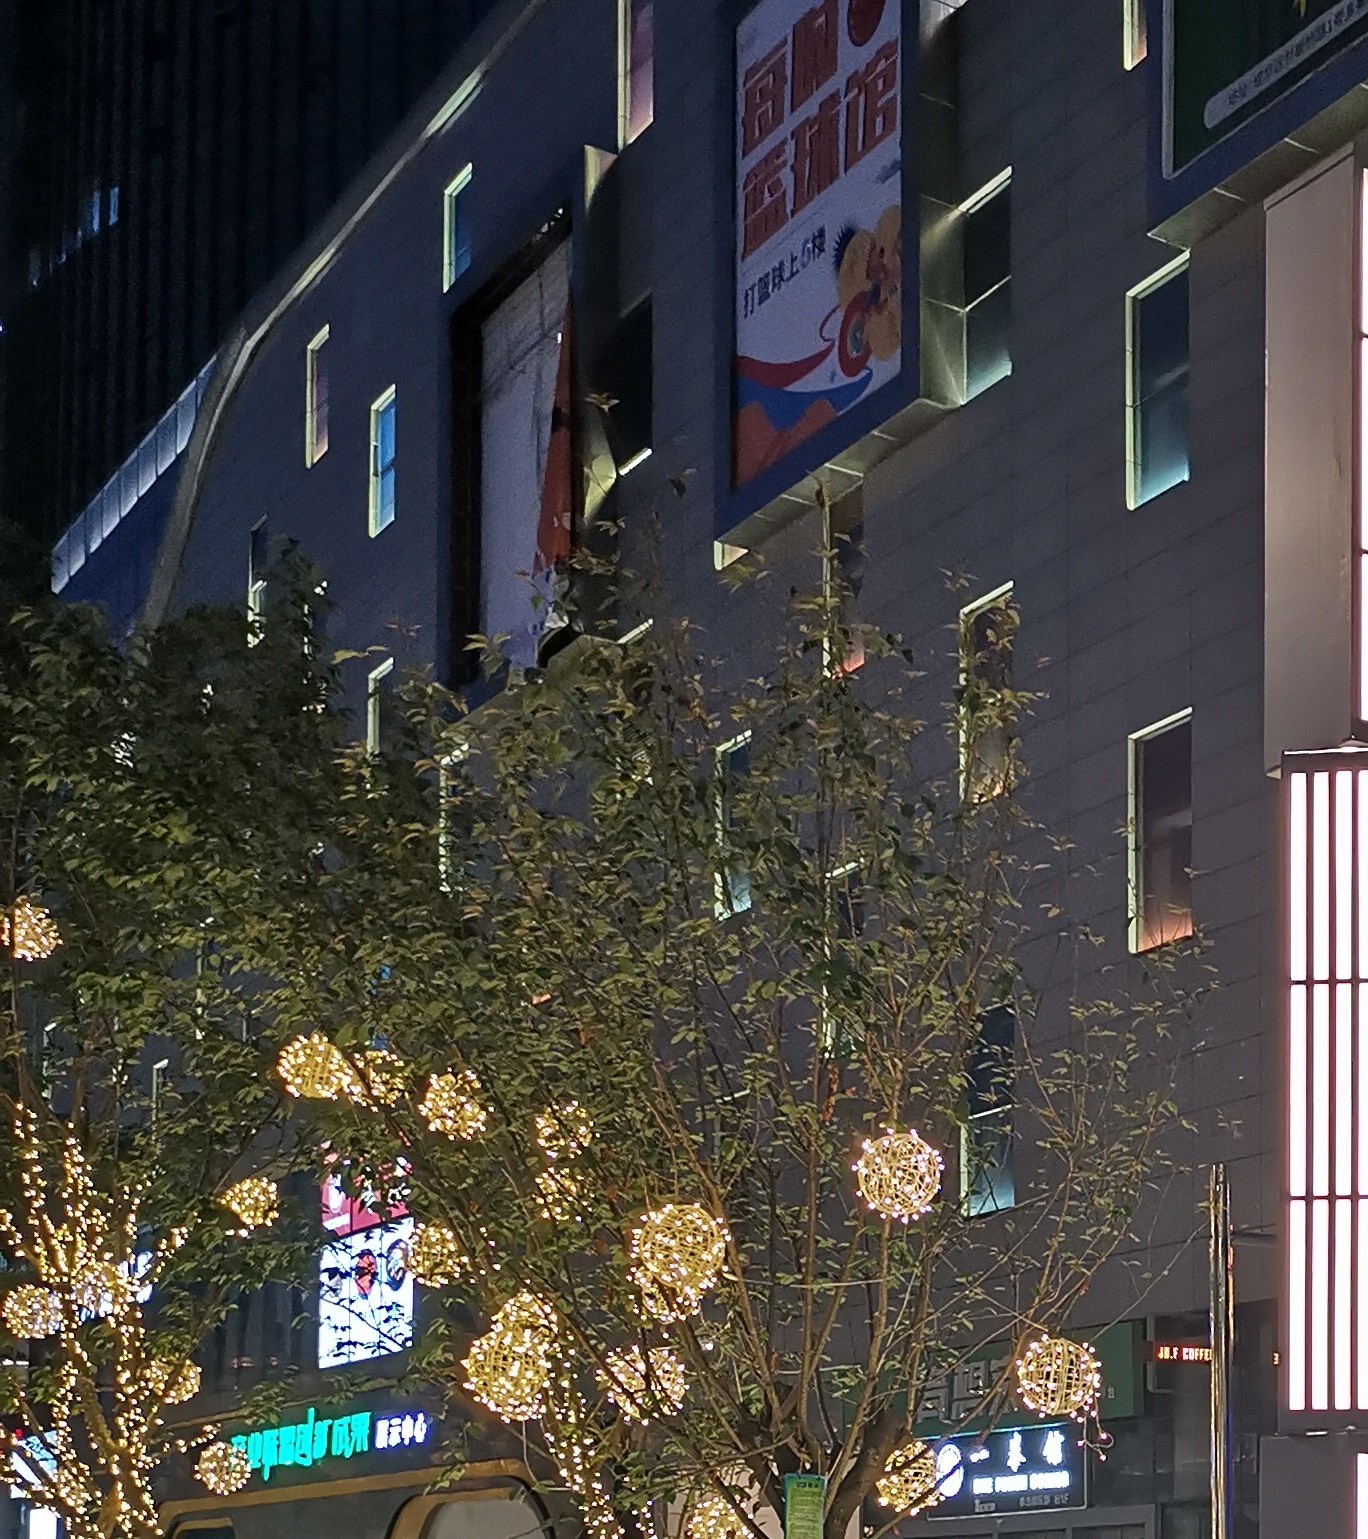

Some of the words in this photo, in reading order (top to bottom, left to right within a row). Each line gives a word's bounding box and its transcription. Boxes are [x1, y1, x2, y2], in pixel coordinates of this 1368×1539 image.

[742, 38, 898, 261] 篮球馆
[744, 225, 826, 319] 打篮球上6楼
[1182, 1347, 1213, 1361] COFFE
